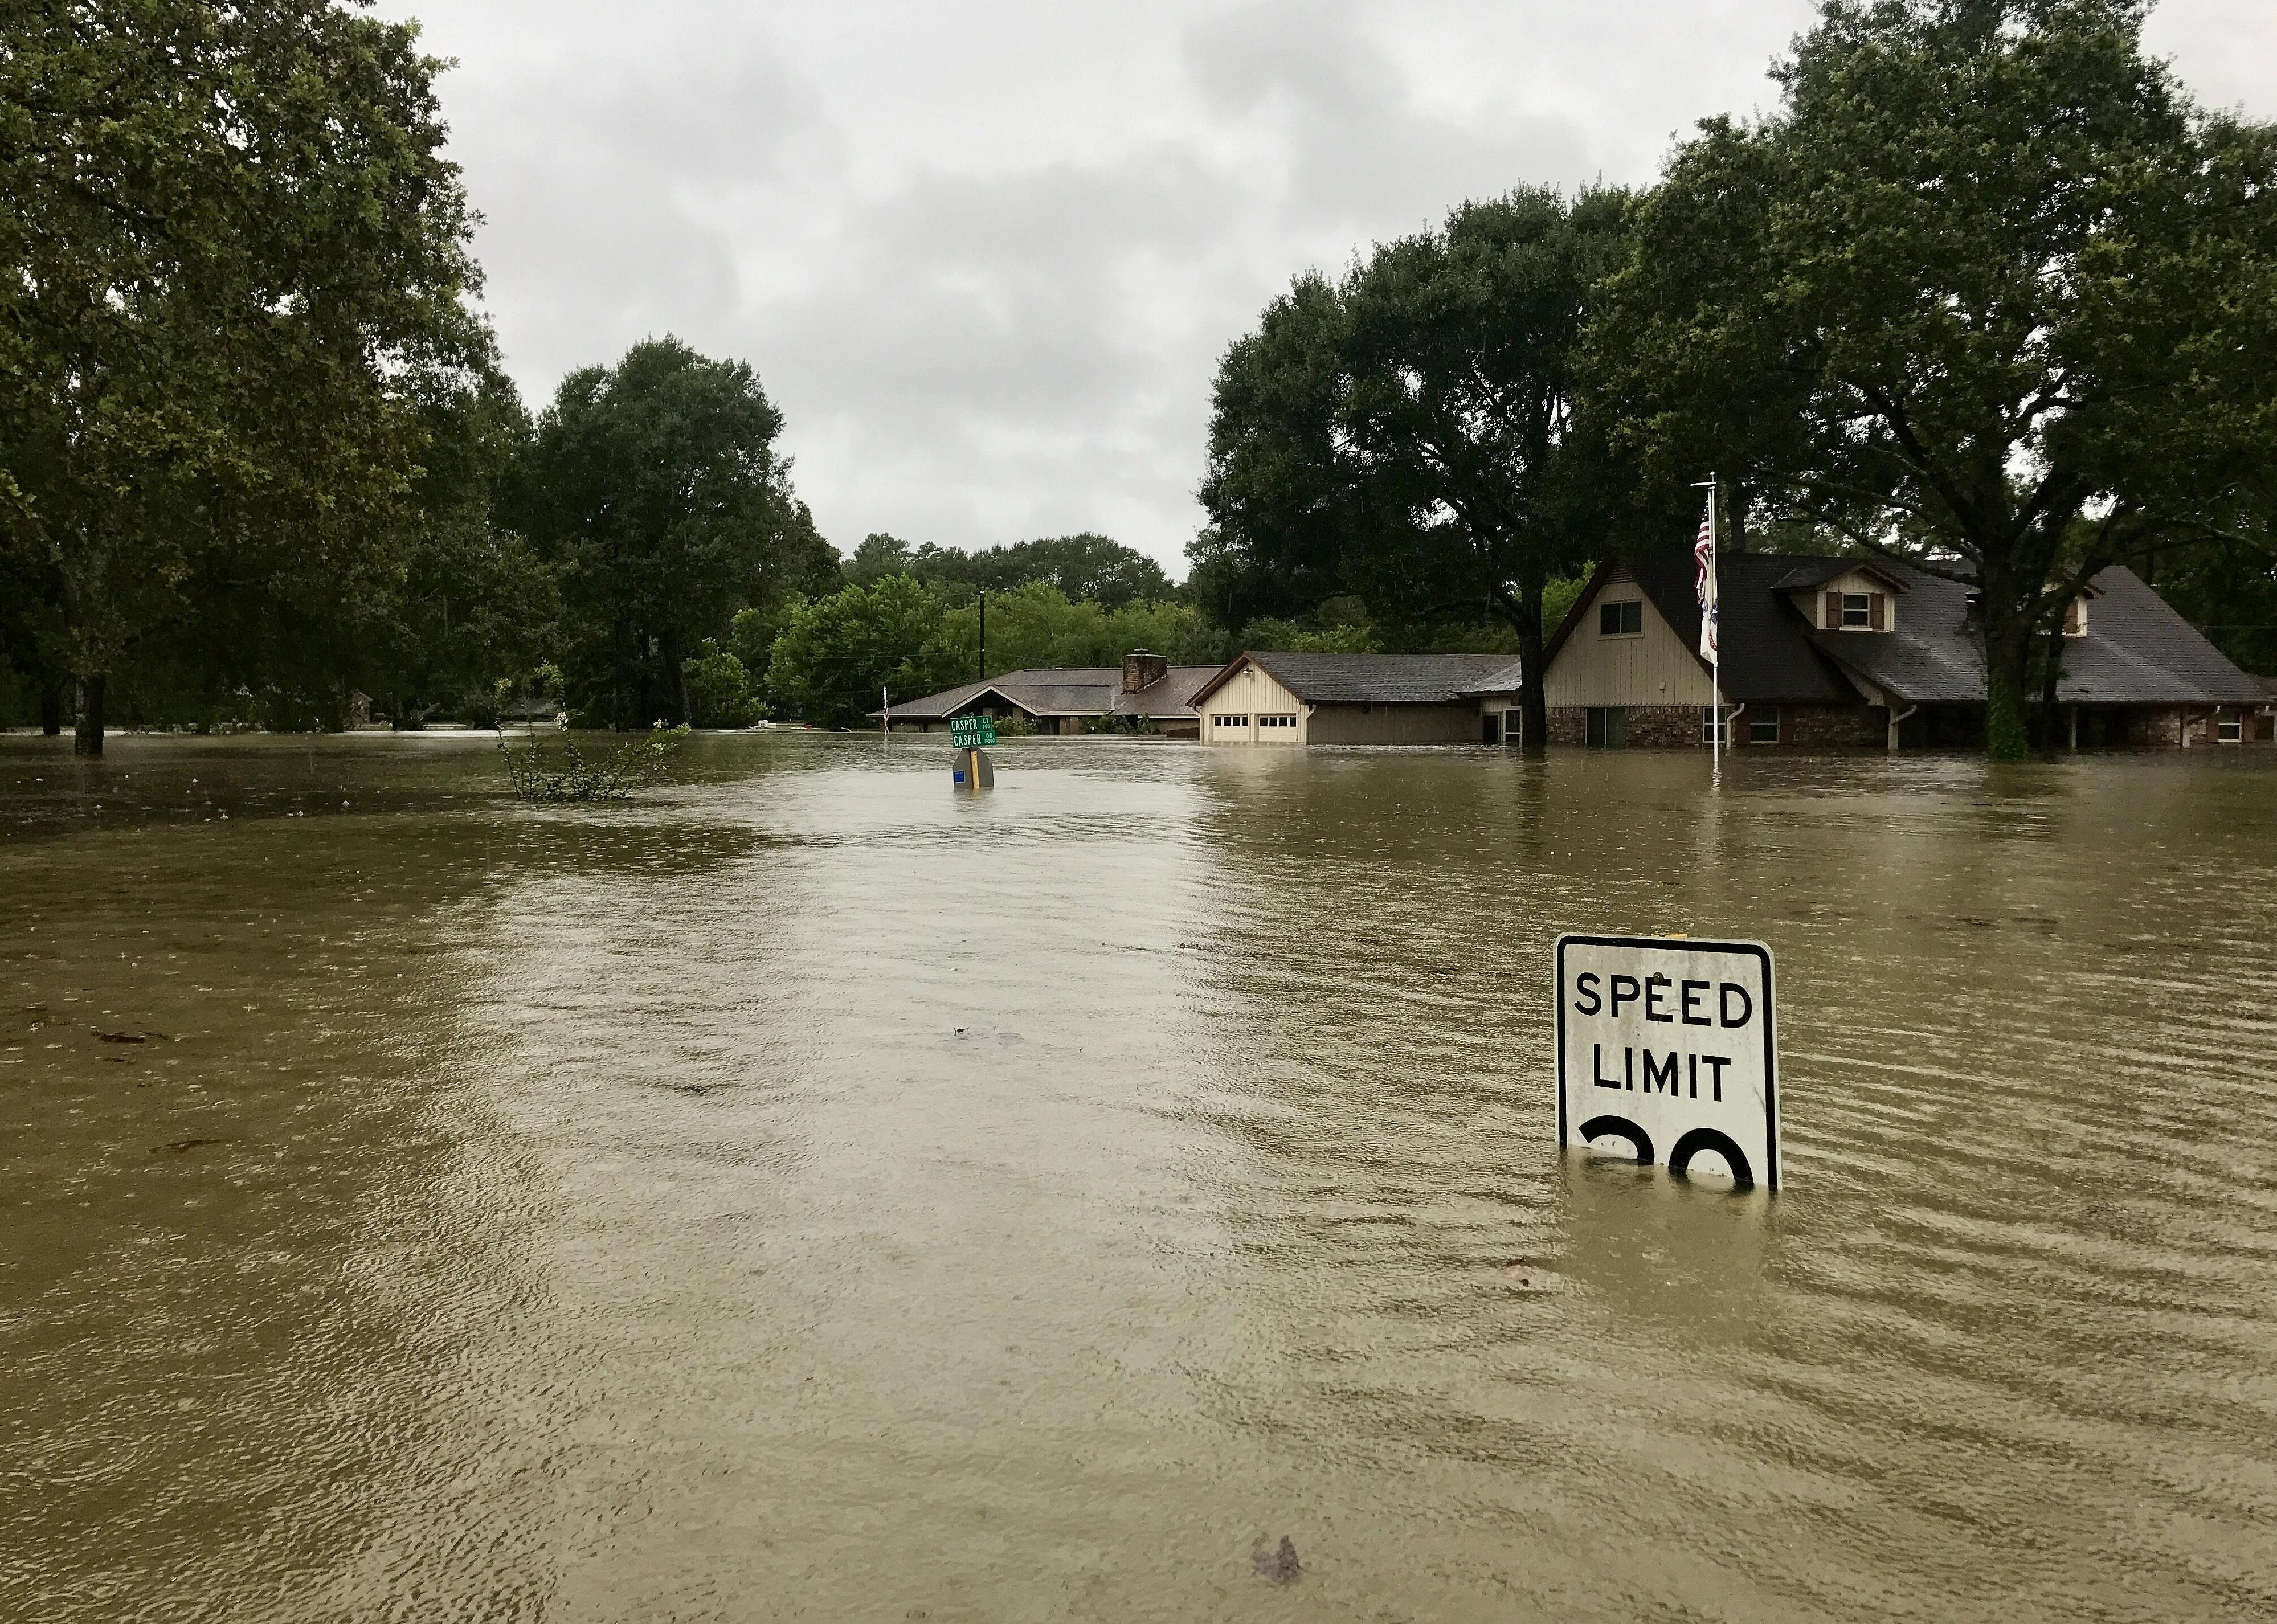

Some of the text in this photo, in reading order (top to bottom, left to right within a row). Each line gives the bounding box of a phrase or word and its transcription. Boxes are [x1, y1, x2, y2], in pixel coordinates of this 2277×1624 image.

[951, 719, 978, 731] CASPER
[954, 734, 982, 746] CASPER
[1573, 972, 1752, 1028] SPEED
[1593, 1044, 1731, 1102] LIMIT
